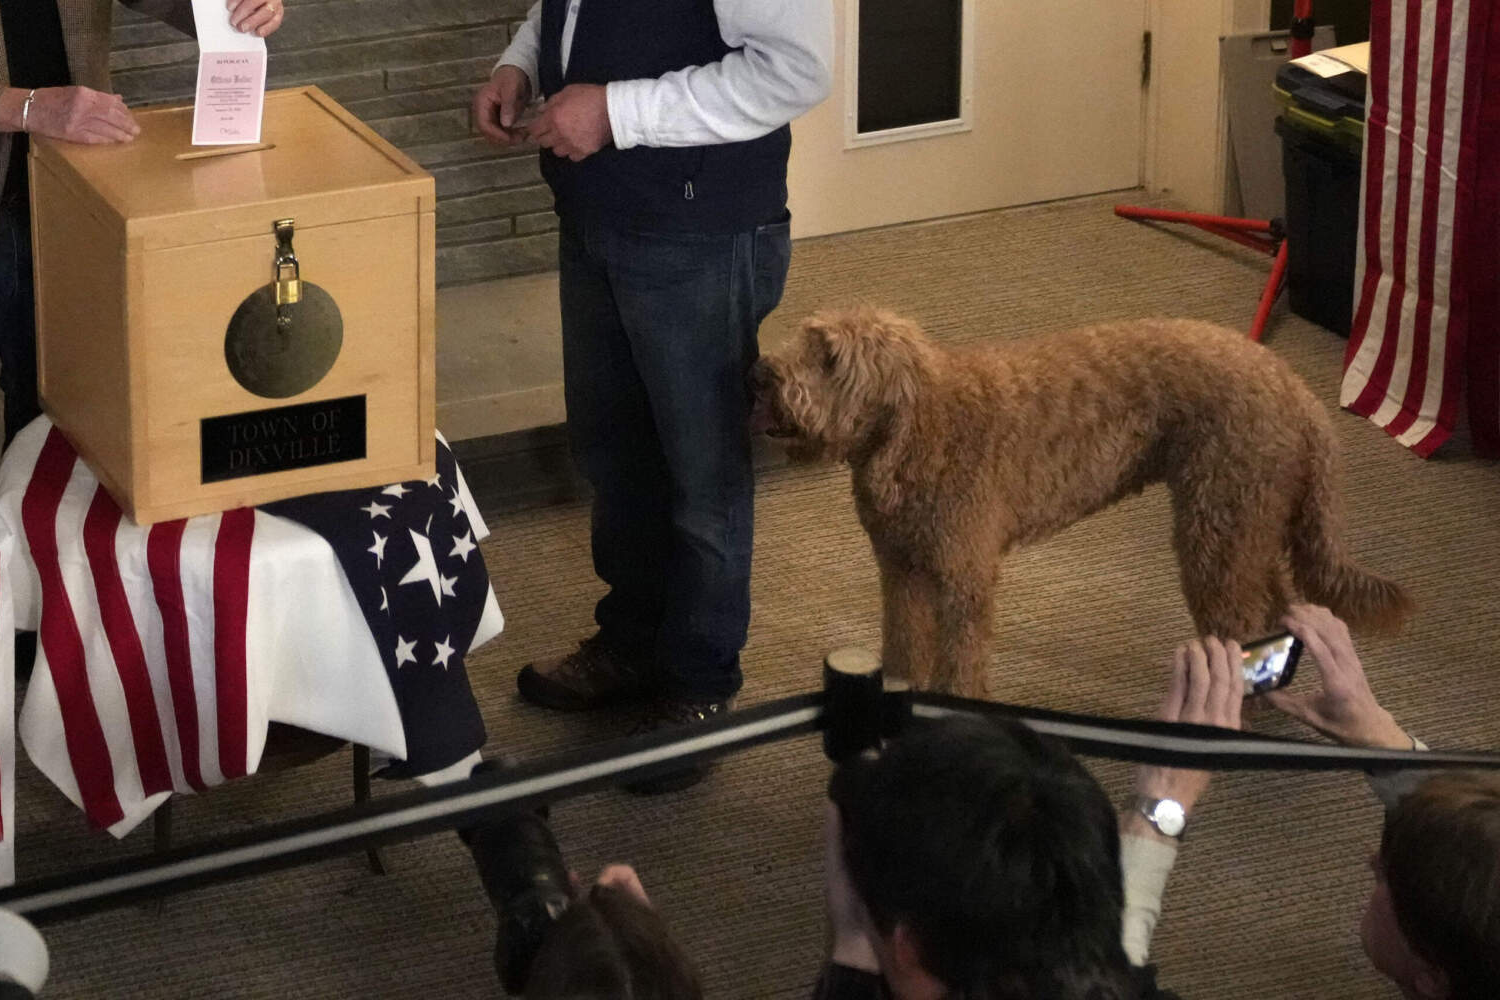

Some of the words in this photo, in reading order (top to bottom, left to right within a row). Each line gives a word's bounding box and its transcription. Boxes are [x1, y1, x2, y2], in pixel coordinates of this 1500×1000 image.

[228, 415, 298, 445] TOWN
[311, 408, 341, 432] OF
[229, 432, 342, 470] DIXVILLE
